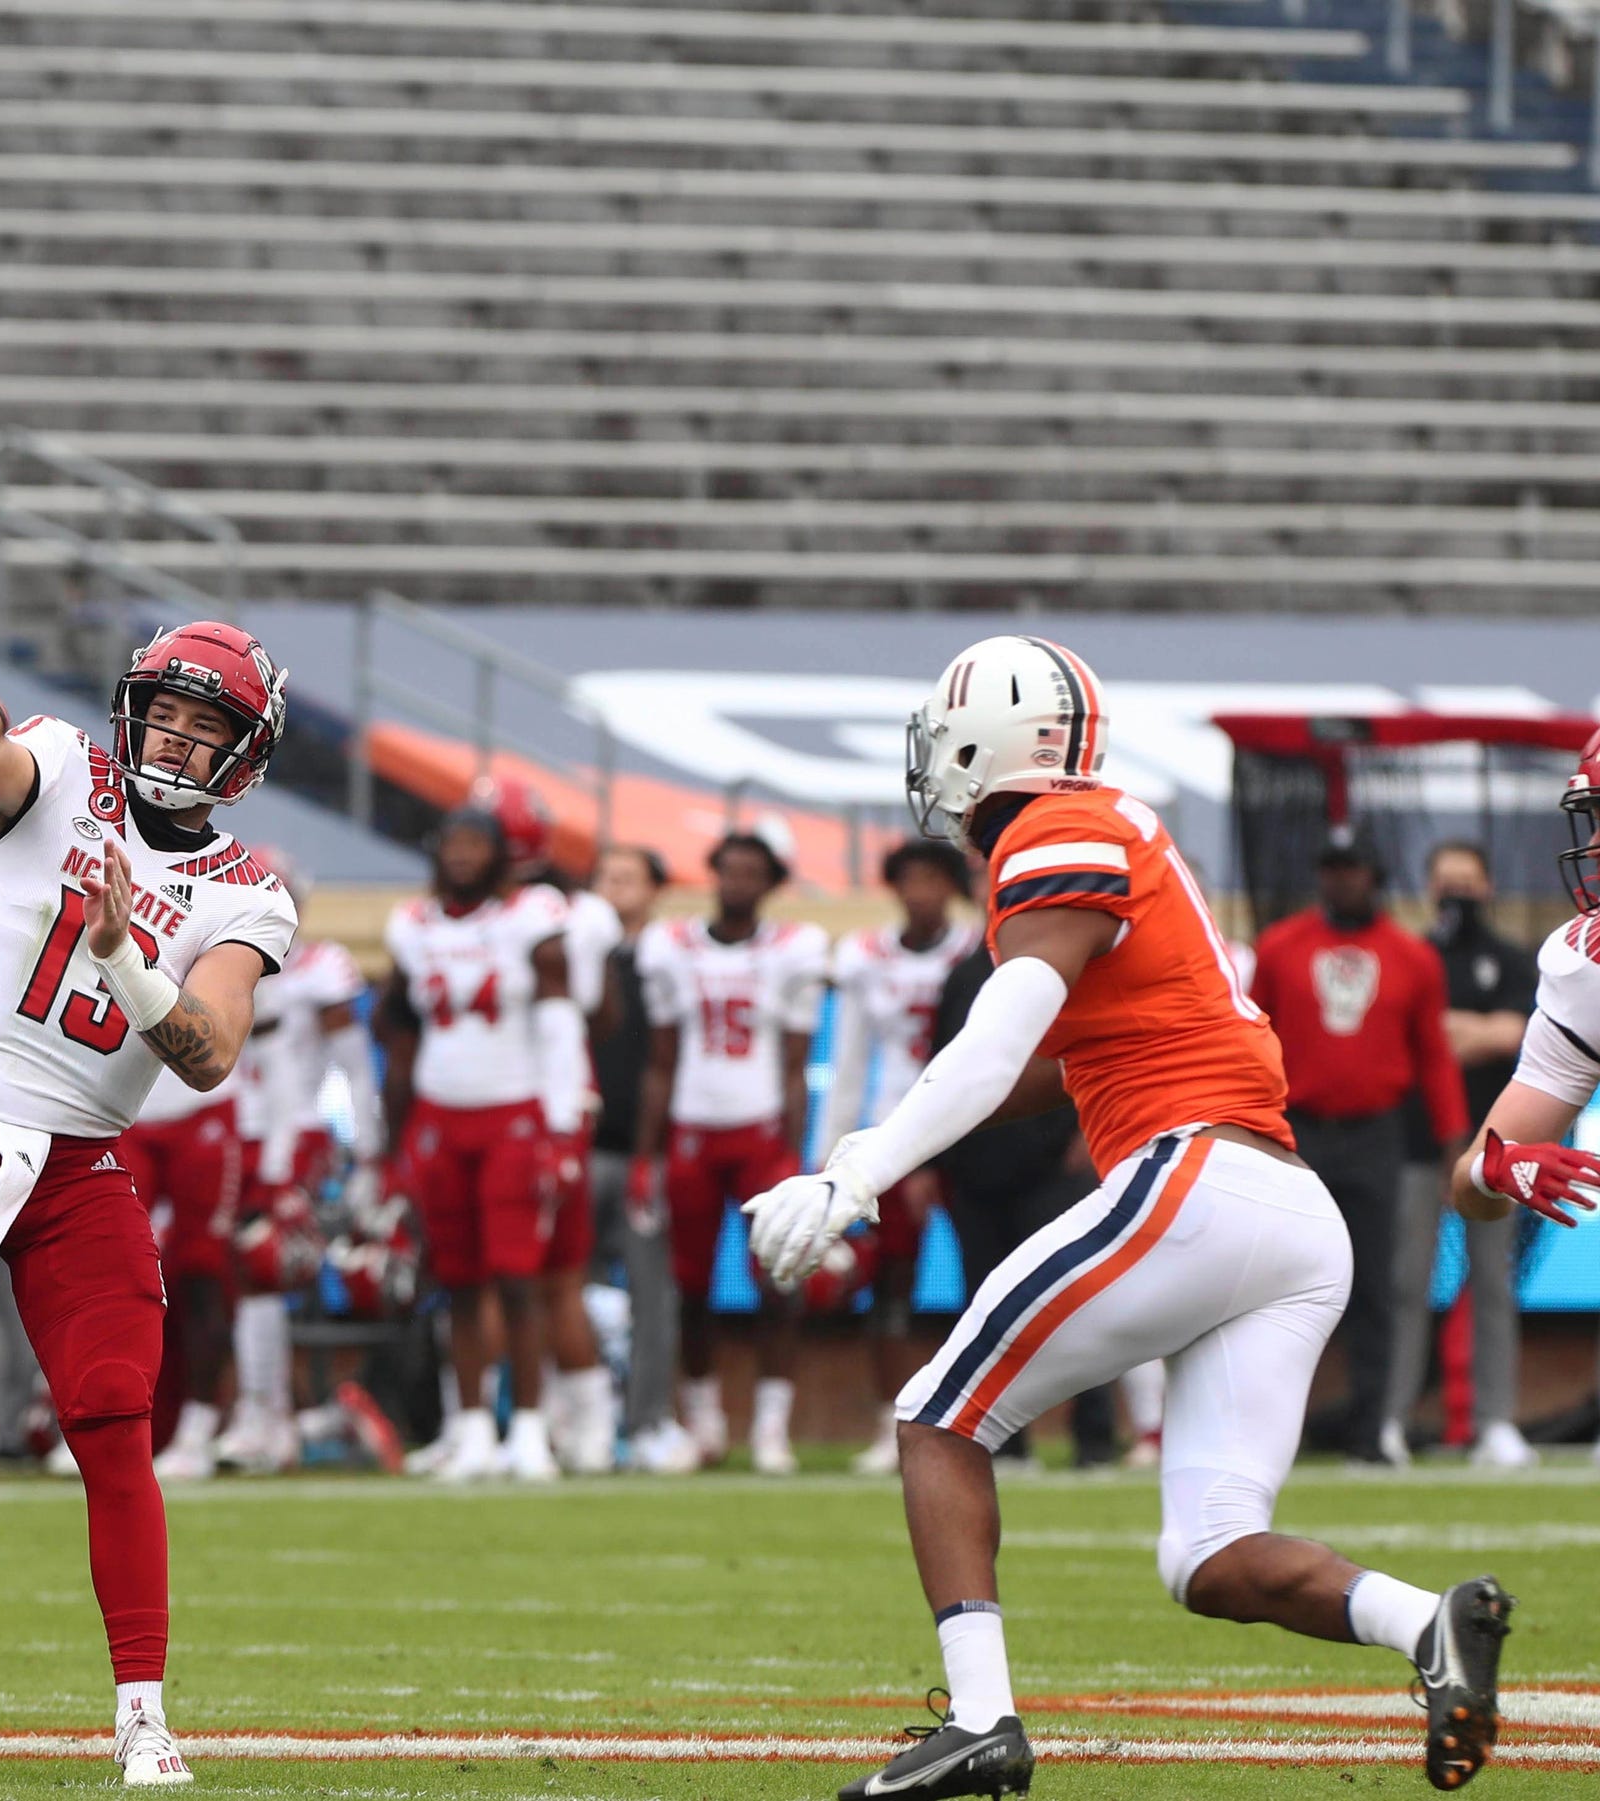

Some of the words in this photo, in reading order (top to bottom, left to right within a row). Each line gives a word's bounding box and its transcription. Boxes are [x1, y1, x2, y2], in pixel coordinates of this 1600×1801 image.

[182, 666, 209, 679] ACC
[75, 820, 99, 836] ACC
[60, 845, 102, 879] NC
[129, 882, 188, 939] TATE
[159, 884, 193, 912] adidas
[16, 883, 160, 1055] 13
